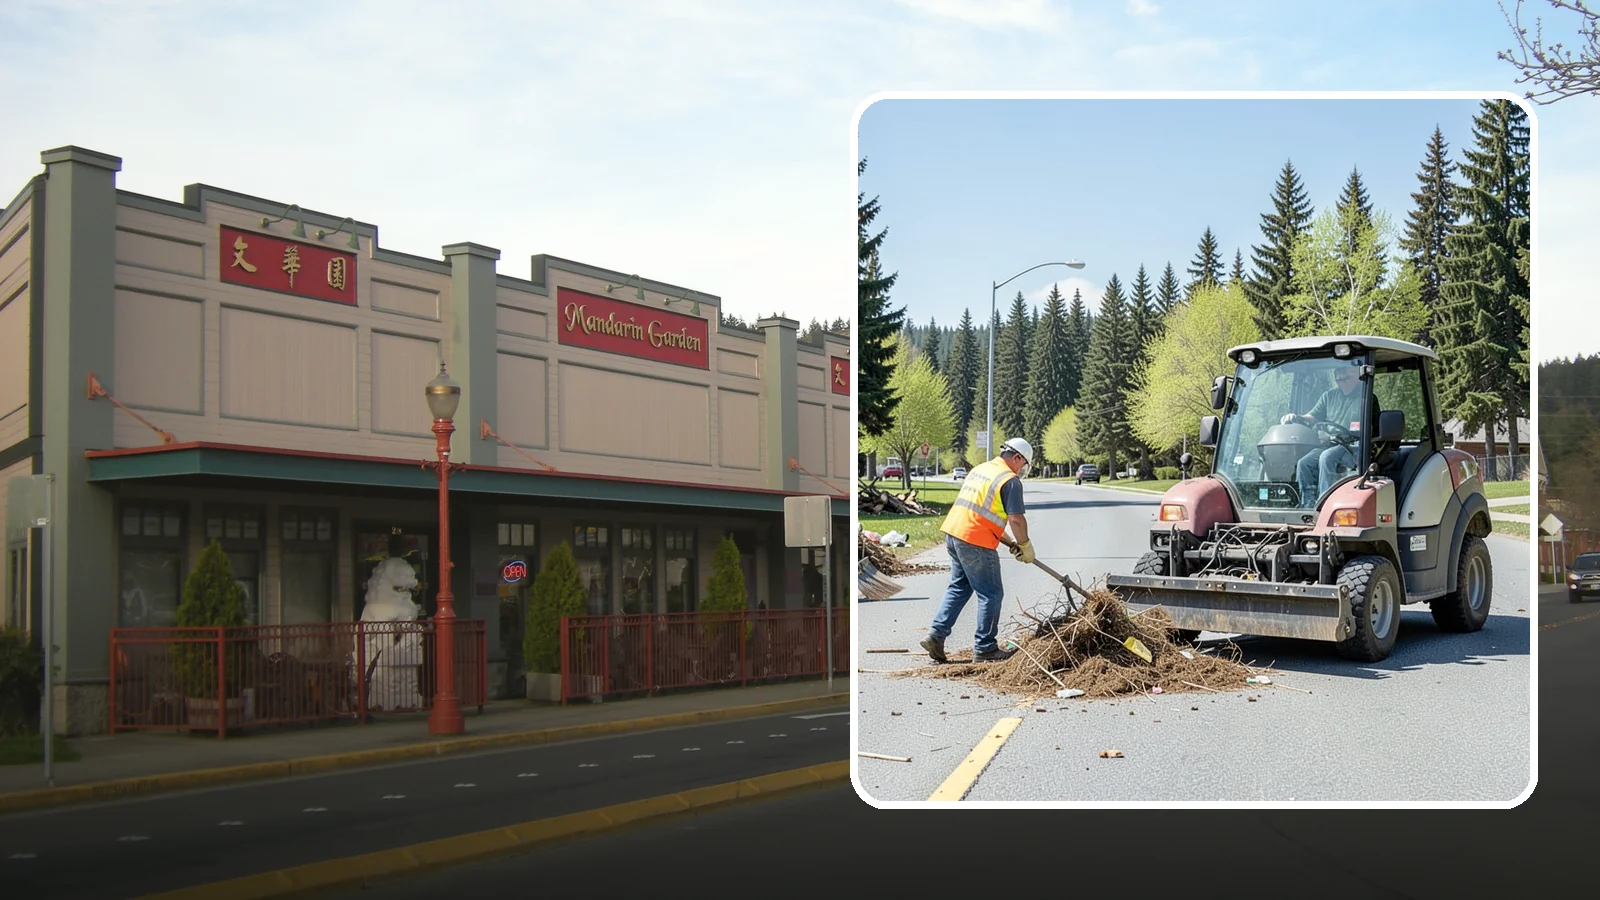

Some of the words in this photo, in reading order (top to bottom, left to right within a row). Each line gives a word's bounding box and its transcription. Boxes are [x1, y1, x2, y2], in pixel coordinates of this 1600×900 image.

[231, 235, 346, 290] 文華園
[565, 302, 644, 341] Mandarin
[648, 320, 701, 352] Garden
[503, 565, 527, 578] OPEN
